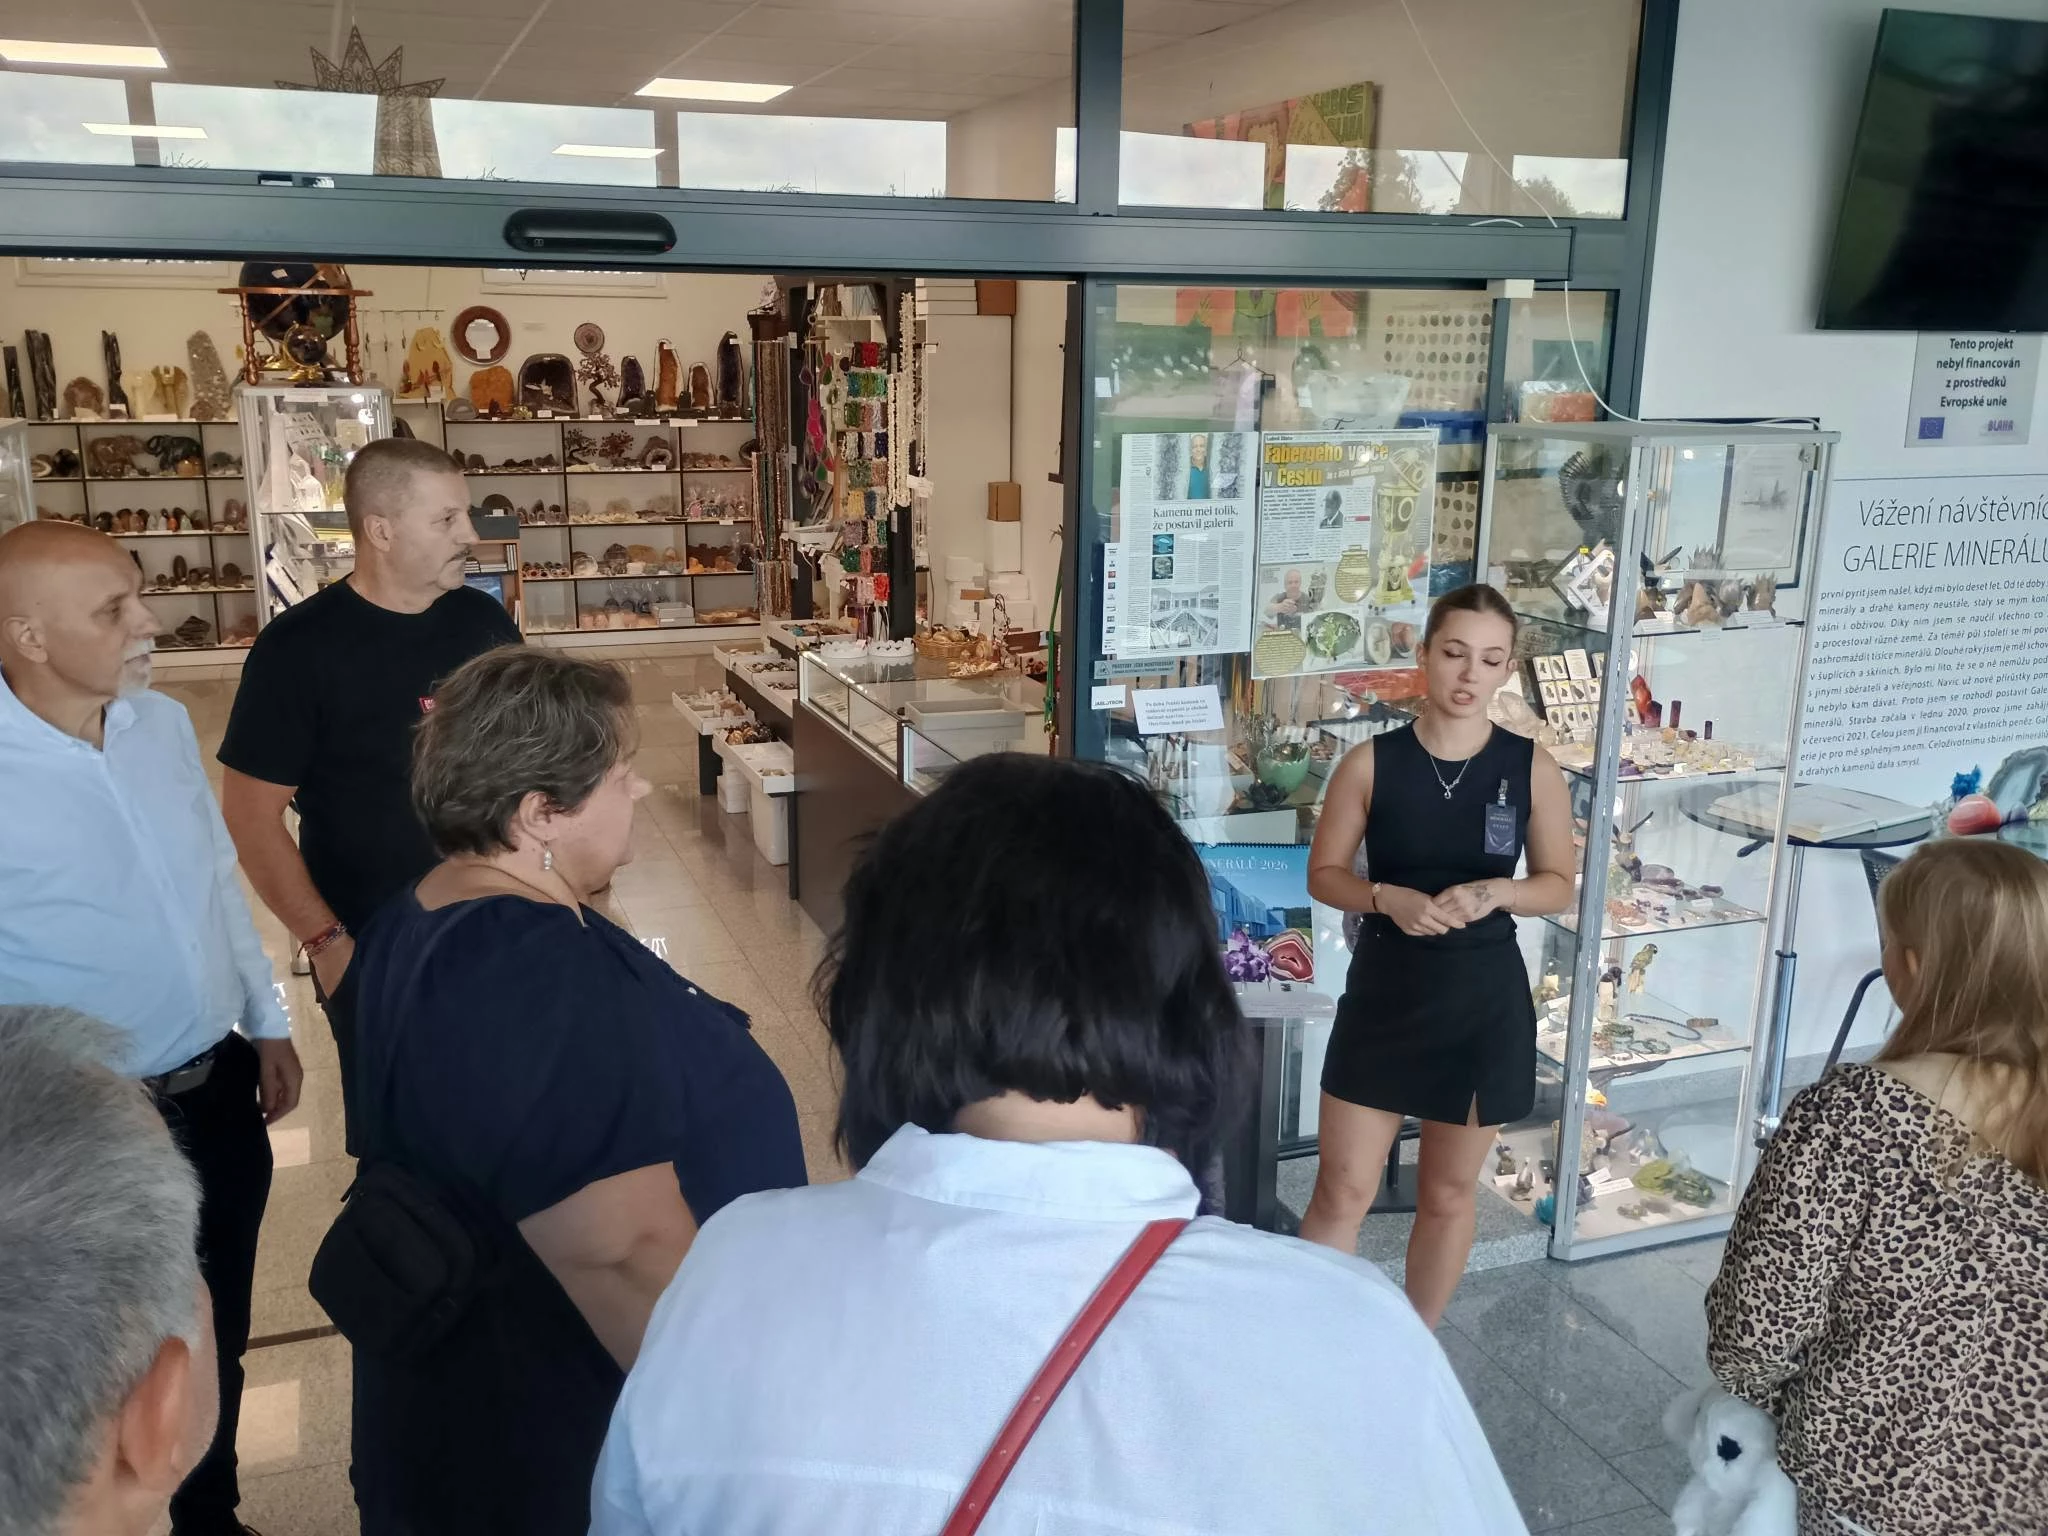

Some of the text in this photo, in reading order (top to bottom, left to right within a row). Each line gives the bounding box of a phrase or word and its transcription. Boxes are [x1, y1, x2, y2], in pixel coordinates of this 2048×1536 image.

[1950, 338, 2014, 352] Tento projekt
[1936, 357, 2021, 372] nebyl financován
[1946, 376, 2007, 391] z prostředků
[1940, 395, 2008, 410] Evropské unie
[1277, 463, 1323, 486] Česku
[1214, 505, 1239, 516] tolik,
[1860, 497, 1934, 526] Vážení
[1165, 518, 1202, 532] postavil
[1203, 517, 1234, 530] galerii
[1843, 542, 1938, 572] GALERIE
[1946, 583, 1964, 594] bylo
[1966, 582, 1988, 592] deset
[2004, 580, 2014, 589] Od
[2026, 579, 2045, 590] doby
[1818, 604, 1856, 615] minerály
[1898, 602, 1930, 612] kameny
[1996, 598, 2004, 606] se
[1932, 616, 1952, 627] jsem
[1958, 616, 1966, 624] se
[1970, 612, 1994, 622] naučil
[1998, 611, 2030, 620] všechno
[1928, 632, 1938, 642] Za
[1984, 628, 2008, 638] století
[2011, 628, 2018, 636] se
[2022, 626, 2032, 634] mi
[1904, 665, 1922, 676] Bylo
[2000, 657, 2030, 667] nemůžu
[1962, 676, 1972, 686] už
[1818, 702, 1848, 713] nebylo
[1852, 701, 1868, 710] kam
[1902, 696, 1924, 704] Proto
[1927, 694, 1946, 705] jsem
[1962, 690, 1992, 700] rozhodl
[1996, 688, 2028, 700] postavit
[1849, 716, 1876, 726] Stavba
[1880, 712, 1906, 722] začala
[1920, 710, 1943, 720] lednu
[1973, 706, 2000, 716] provoz
[2004, 704, 2022, 714] jsme
[1809, 734, 1844, 745] červenci
[1870, 730, 1894, 739] Celou
[1924, 722, 1966, 734] financoval
[1972, 719, 2006, 730] vlastních
[1828, 751, 1843, 760] pro
[1806, 765, 1840, 777] drahých
[1877, 760, 1894, 770] dala
[1261, 860, 1288, 870] 2026
